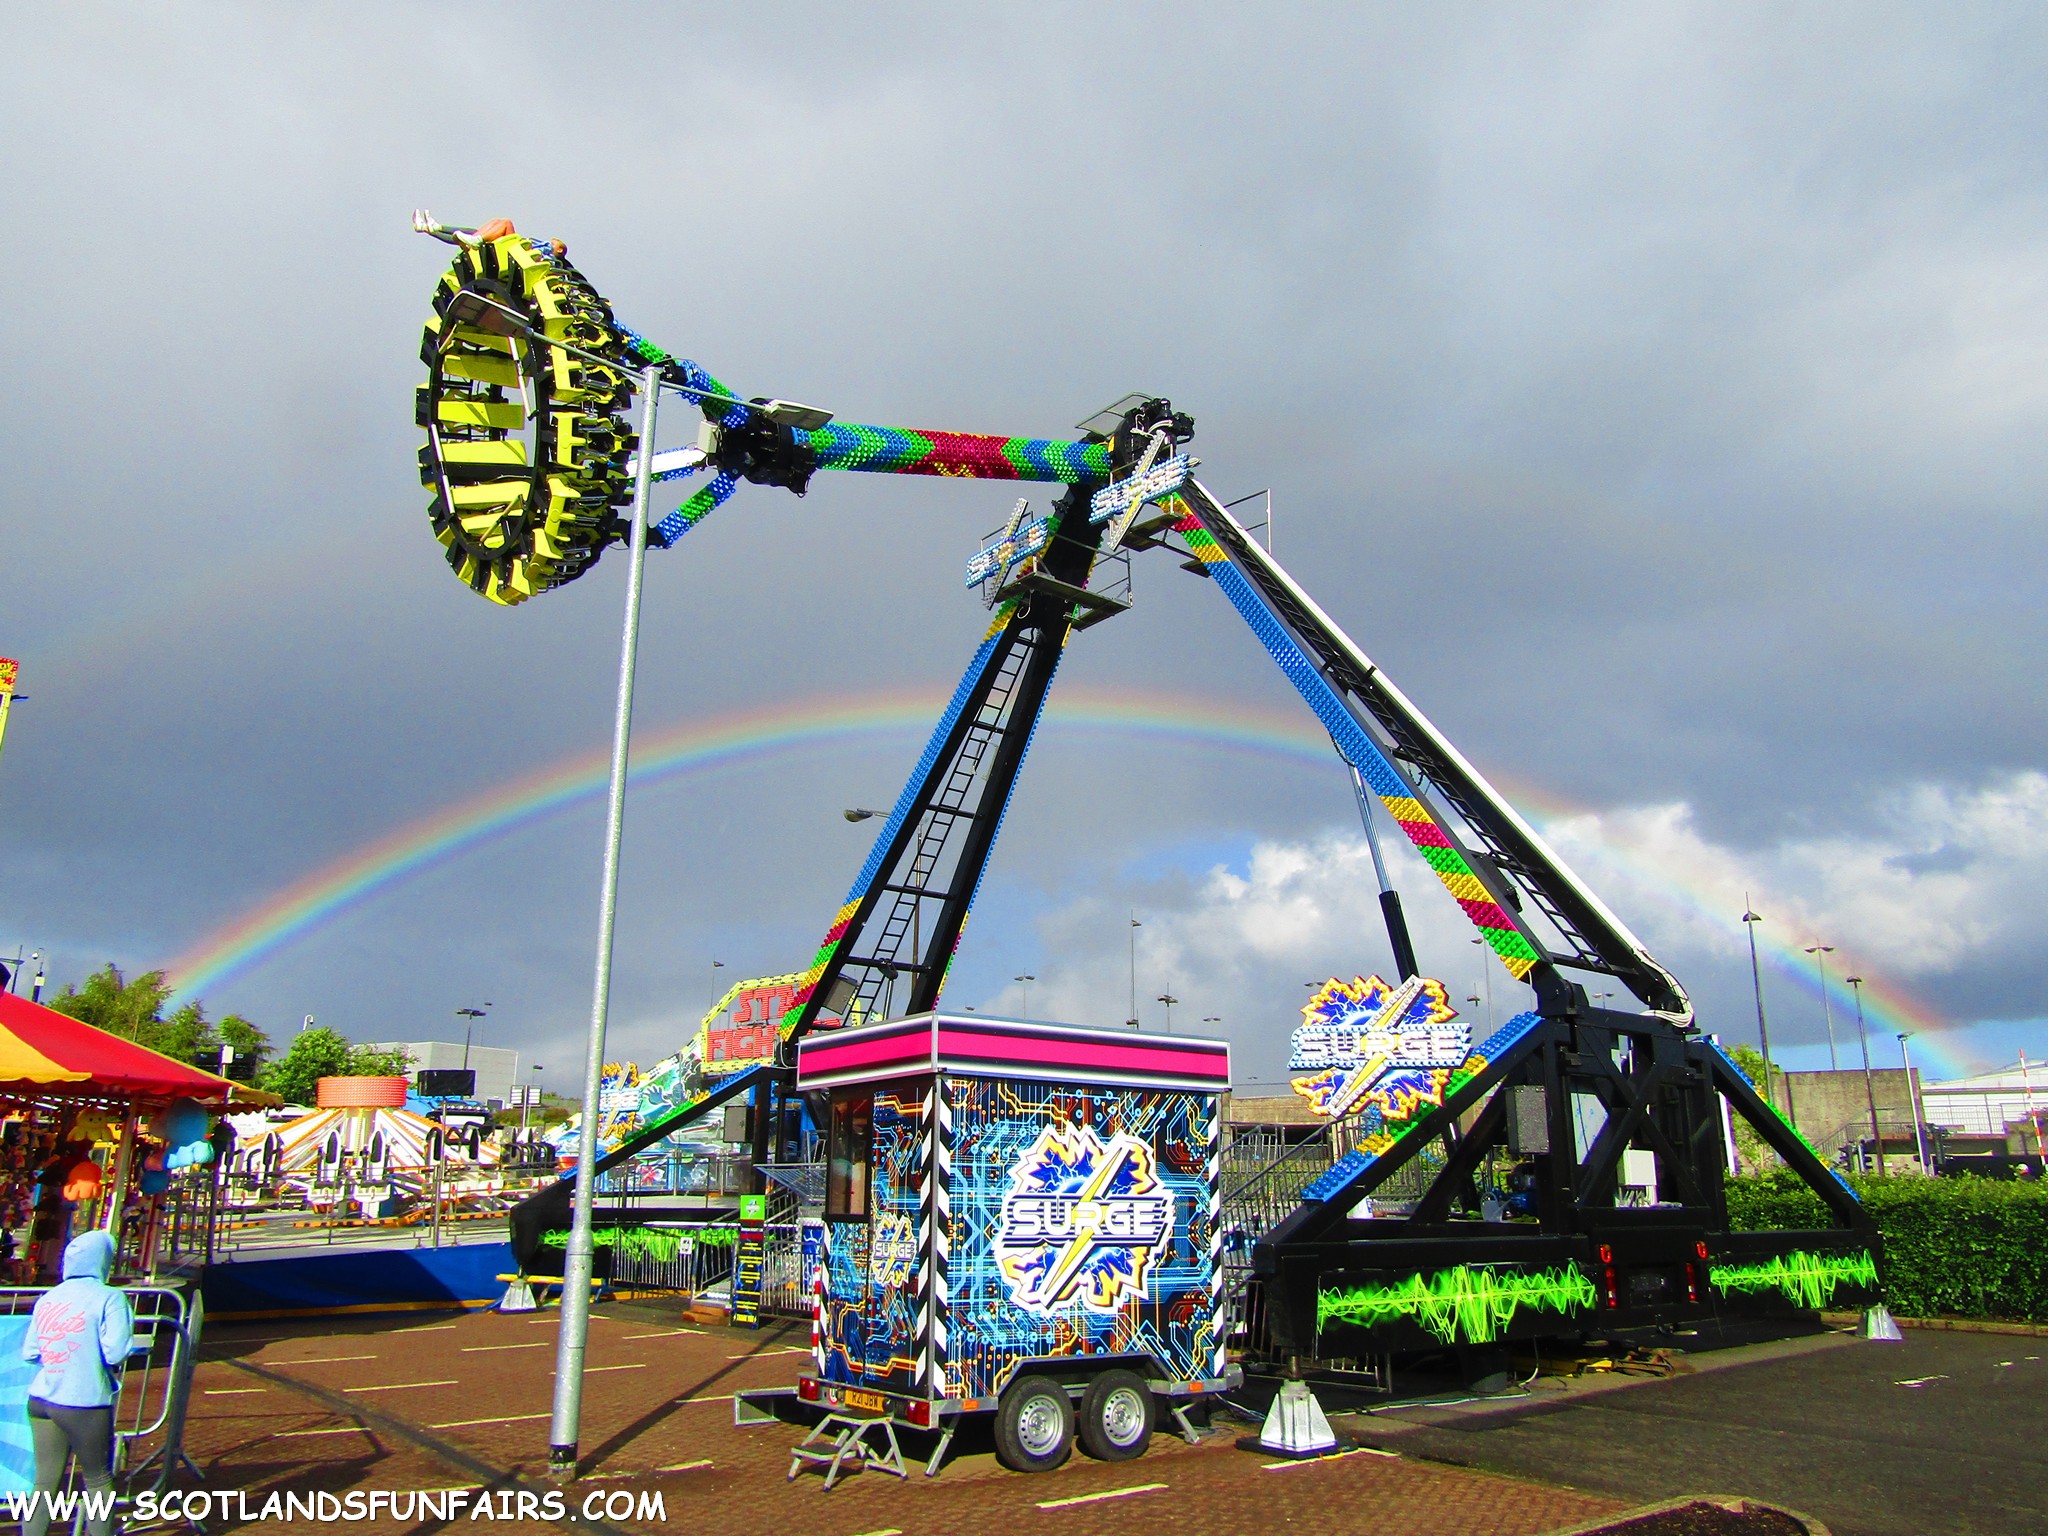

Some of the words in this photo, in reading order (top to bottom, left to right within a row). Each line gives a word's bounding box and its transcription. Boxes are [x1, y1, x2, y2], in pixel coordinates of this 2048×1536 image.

[732, 985, 795, 1022] STA
[1297, 1031, 1463, 1061] SURGE
[1011, 1199, 1158, 1237] SURGE
[874, 1241, 915, 1259] SURGE
